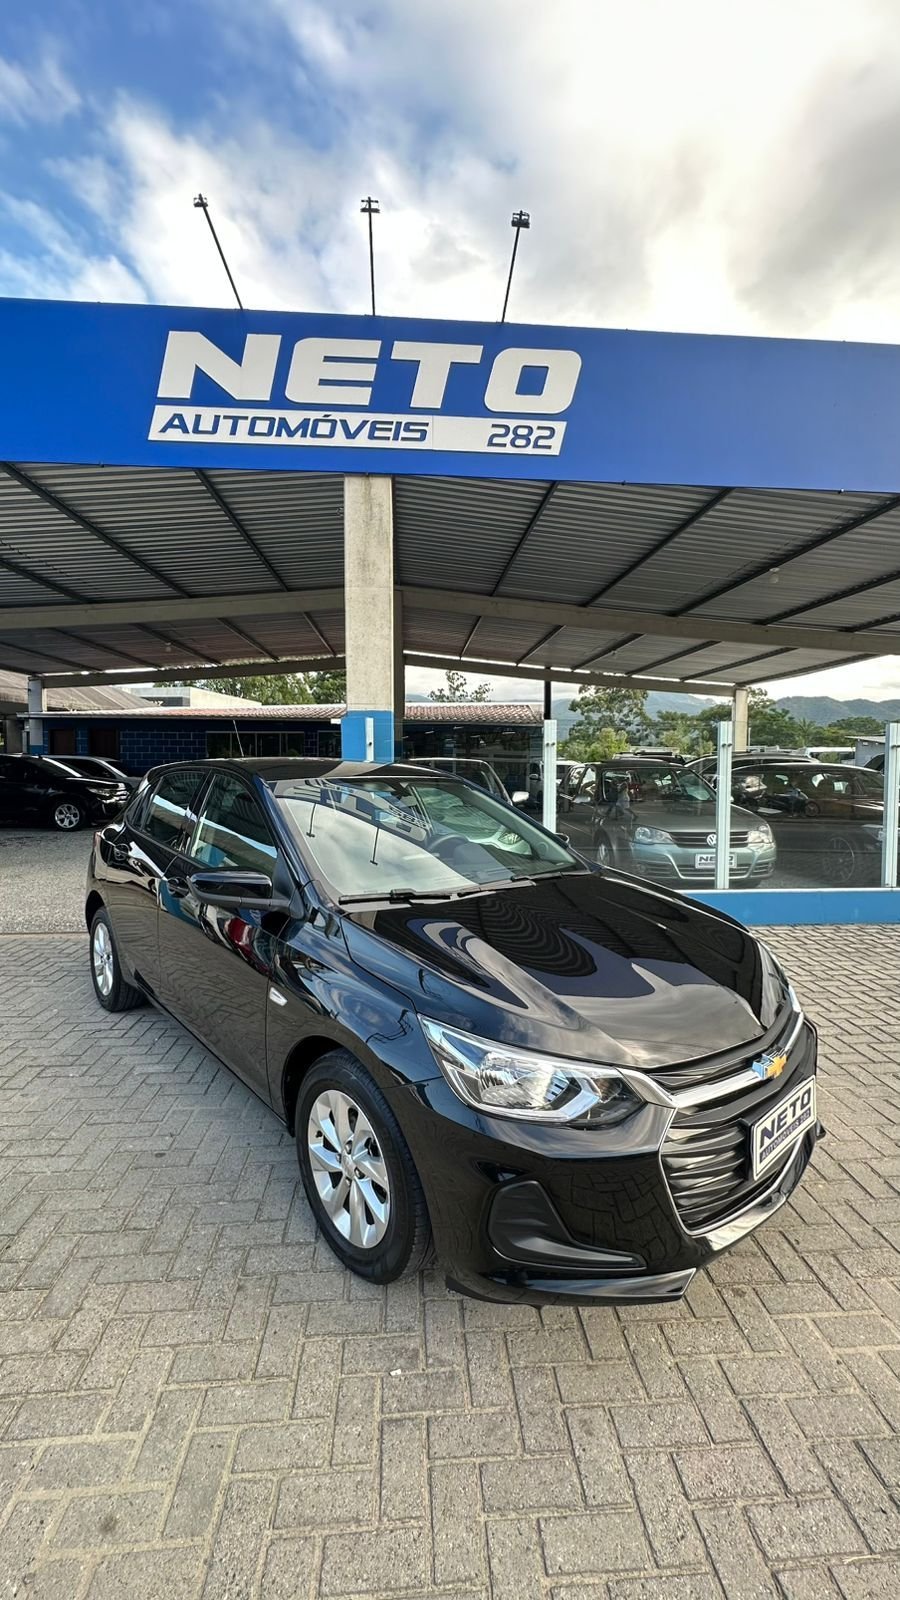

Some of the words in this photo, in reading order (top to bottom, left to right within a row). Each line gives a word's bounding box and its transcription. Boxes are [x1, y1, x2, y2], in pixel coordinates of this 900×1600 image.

[157, 331, 582, 414] NETO
[158, 413, 429, 442] AUTOMÓVEIS
[487, 424, 556, 450] 282
[760, 1087, 811, 1150] NETO
